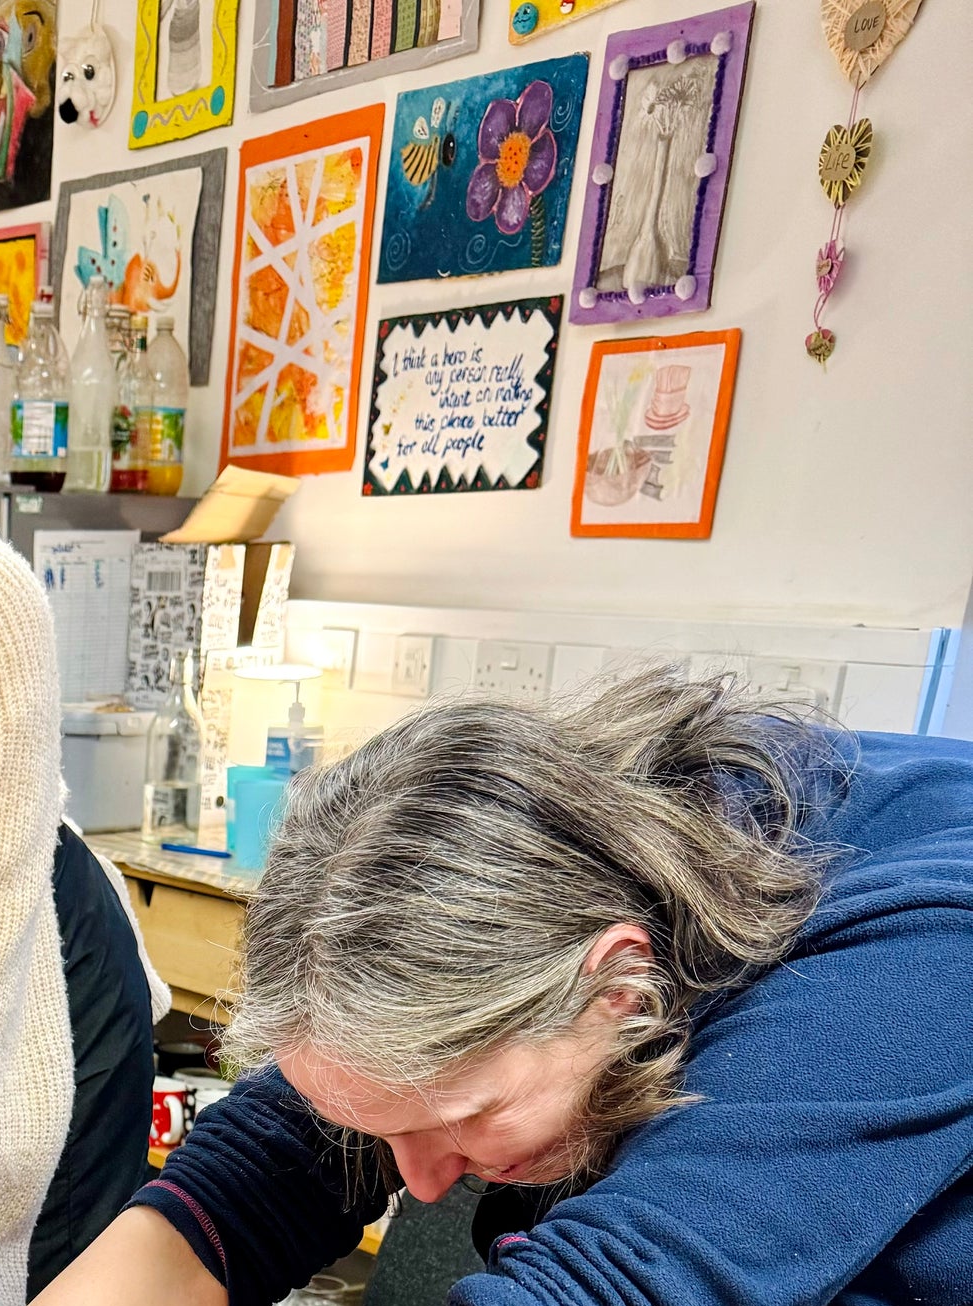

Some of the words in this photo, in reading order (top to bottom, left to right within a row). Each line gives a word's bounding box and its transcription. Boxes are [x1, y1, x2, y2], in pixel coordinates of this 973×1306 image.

[854, 16, 880, 33] LOVE
[825, 146, 850, 170] Life
[402, 347, 426, 371] think
[430, 354, 438, 366] a
[442, 342, 466, 366] hero
[470, 342, 483, 363] is
[425, 370, 443, 396] any
[476, 388, 492, 403] on
[415, 412, 434, 431] this
[482, 405, 526, 427] better
[397, 434, 417, 457] for
[421, 434, 439, 455] all
[441, 430, 485, 458] people
